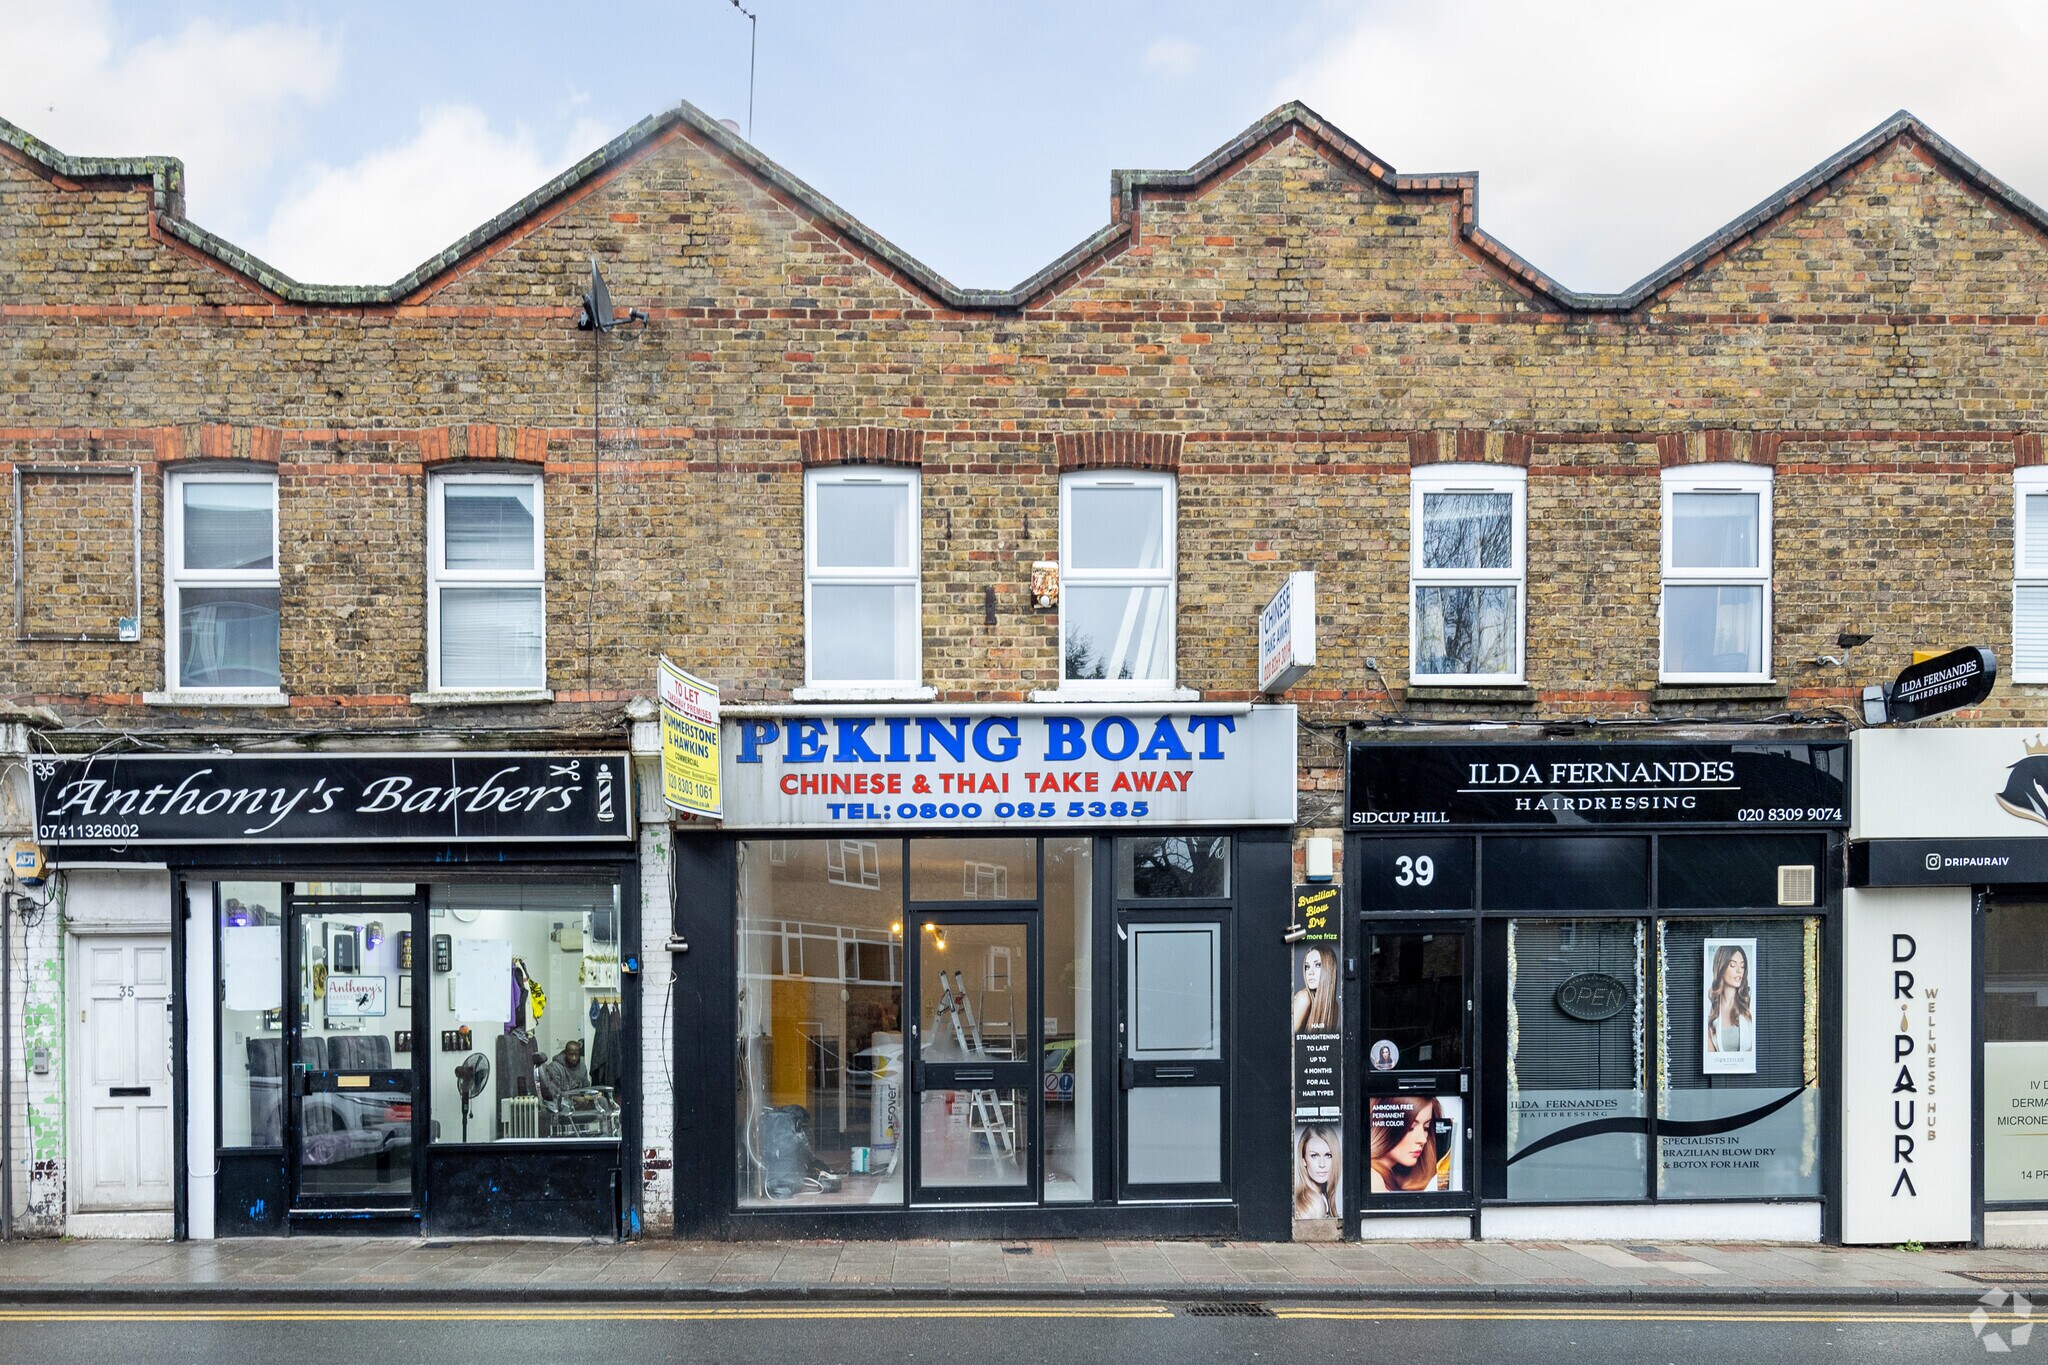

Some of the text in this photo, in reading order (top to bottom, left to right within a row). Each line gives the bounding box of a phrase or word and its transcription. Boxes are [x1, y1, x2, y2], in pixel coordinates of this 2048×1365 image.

[1264, 586, 1290, 635] CHINESE
[1264, 632, 1276, 657] TAKE
[1901, 660, 1977, 693] ILDA FERNANDES
[674, 680, 699, 704] TO LET
[1909, 678, 1968, 703] HAIRDRESSING
[687, 702, 712, 720] PREMISES
[664, 709, 717, 746] HUMMERSTONE
[668, 731, 709, 758] & HAWKINS
[736, 715, 1236, 764] PEKING BOAT
[36, 762, 55, 775] 35
[675, 752, 699, 768] COMMERCIAL
[1469, 761, 1735, 784] ILDA FERNANDES
[668, 772, 712, 800] 020 8303 1061
[780, 771, 1193, 795] CHINESE & THAI TAKE AWAY
[48, 766, 582, 834] Anthony's Barbers
[1515, 796, 1696, 811] HAIRDRESSING
[994, 802, 1056, 818] 085
[1067, 801, 1149, 817] 5385
[1352, 811, 1450, 824] SIDCUP HILL
[1738, 807, 1842, 821] 020 8309 9074
[40, 825, 139, 838] 07411326002
[16, 855, 35, 866] ADT
[1945, 857, 2009, 867] DRIPAURAIV
[1395, 855, 1434, 886] 39
[1298, 889, 1338, 907] Brazilian
[1306, 904, 1329, 917] Blow
[1308, 917, 1327, 929] Dry
[120, 986, 134, 998] 35
[330, 980, 383, 1001] Anthony's
[1562, 985, 1623, 1007] OPEN
[1925, 988, 1939, 1140] WELLNESS HUB
[2030, 1081, 2041, 1089] IV
[888, 1084, 896, 1125] isover
[1511, 1099, 1618, 1108] ILDA FERNANDES
[1997, 1116, 2048, 1125] MICRONE
[1662, 1137, 1725, 1145] SPECIALISTS
[1662, 1149, 1719, 1157] BRAZILIAN
[1755, 1148, 1776, 1156] DRY
[1663, 1161, 1670, 1169] &
[1673, 1161, 1708, 1169] BOTOX
[2021, 1170, 2032, 1179] 14
